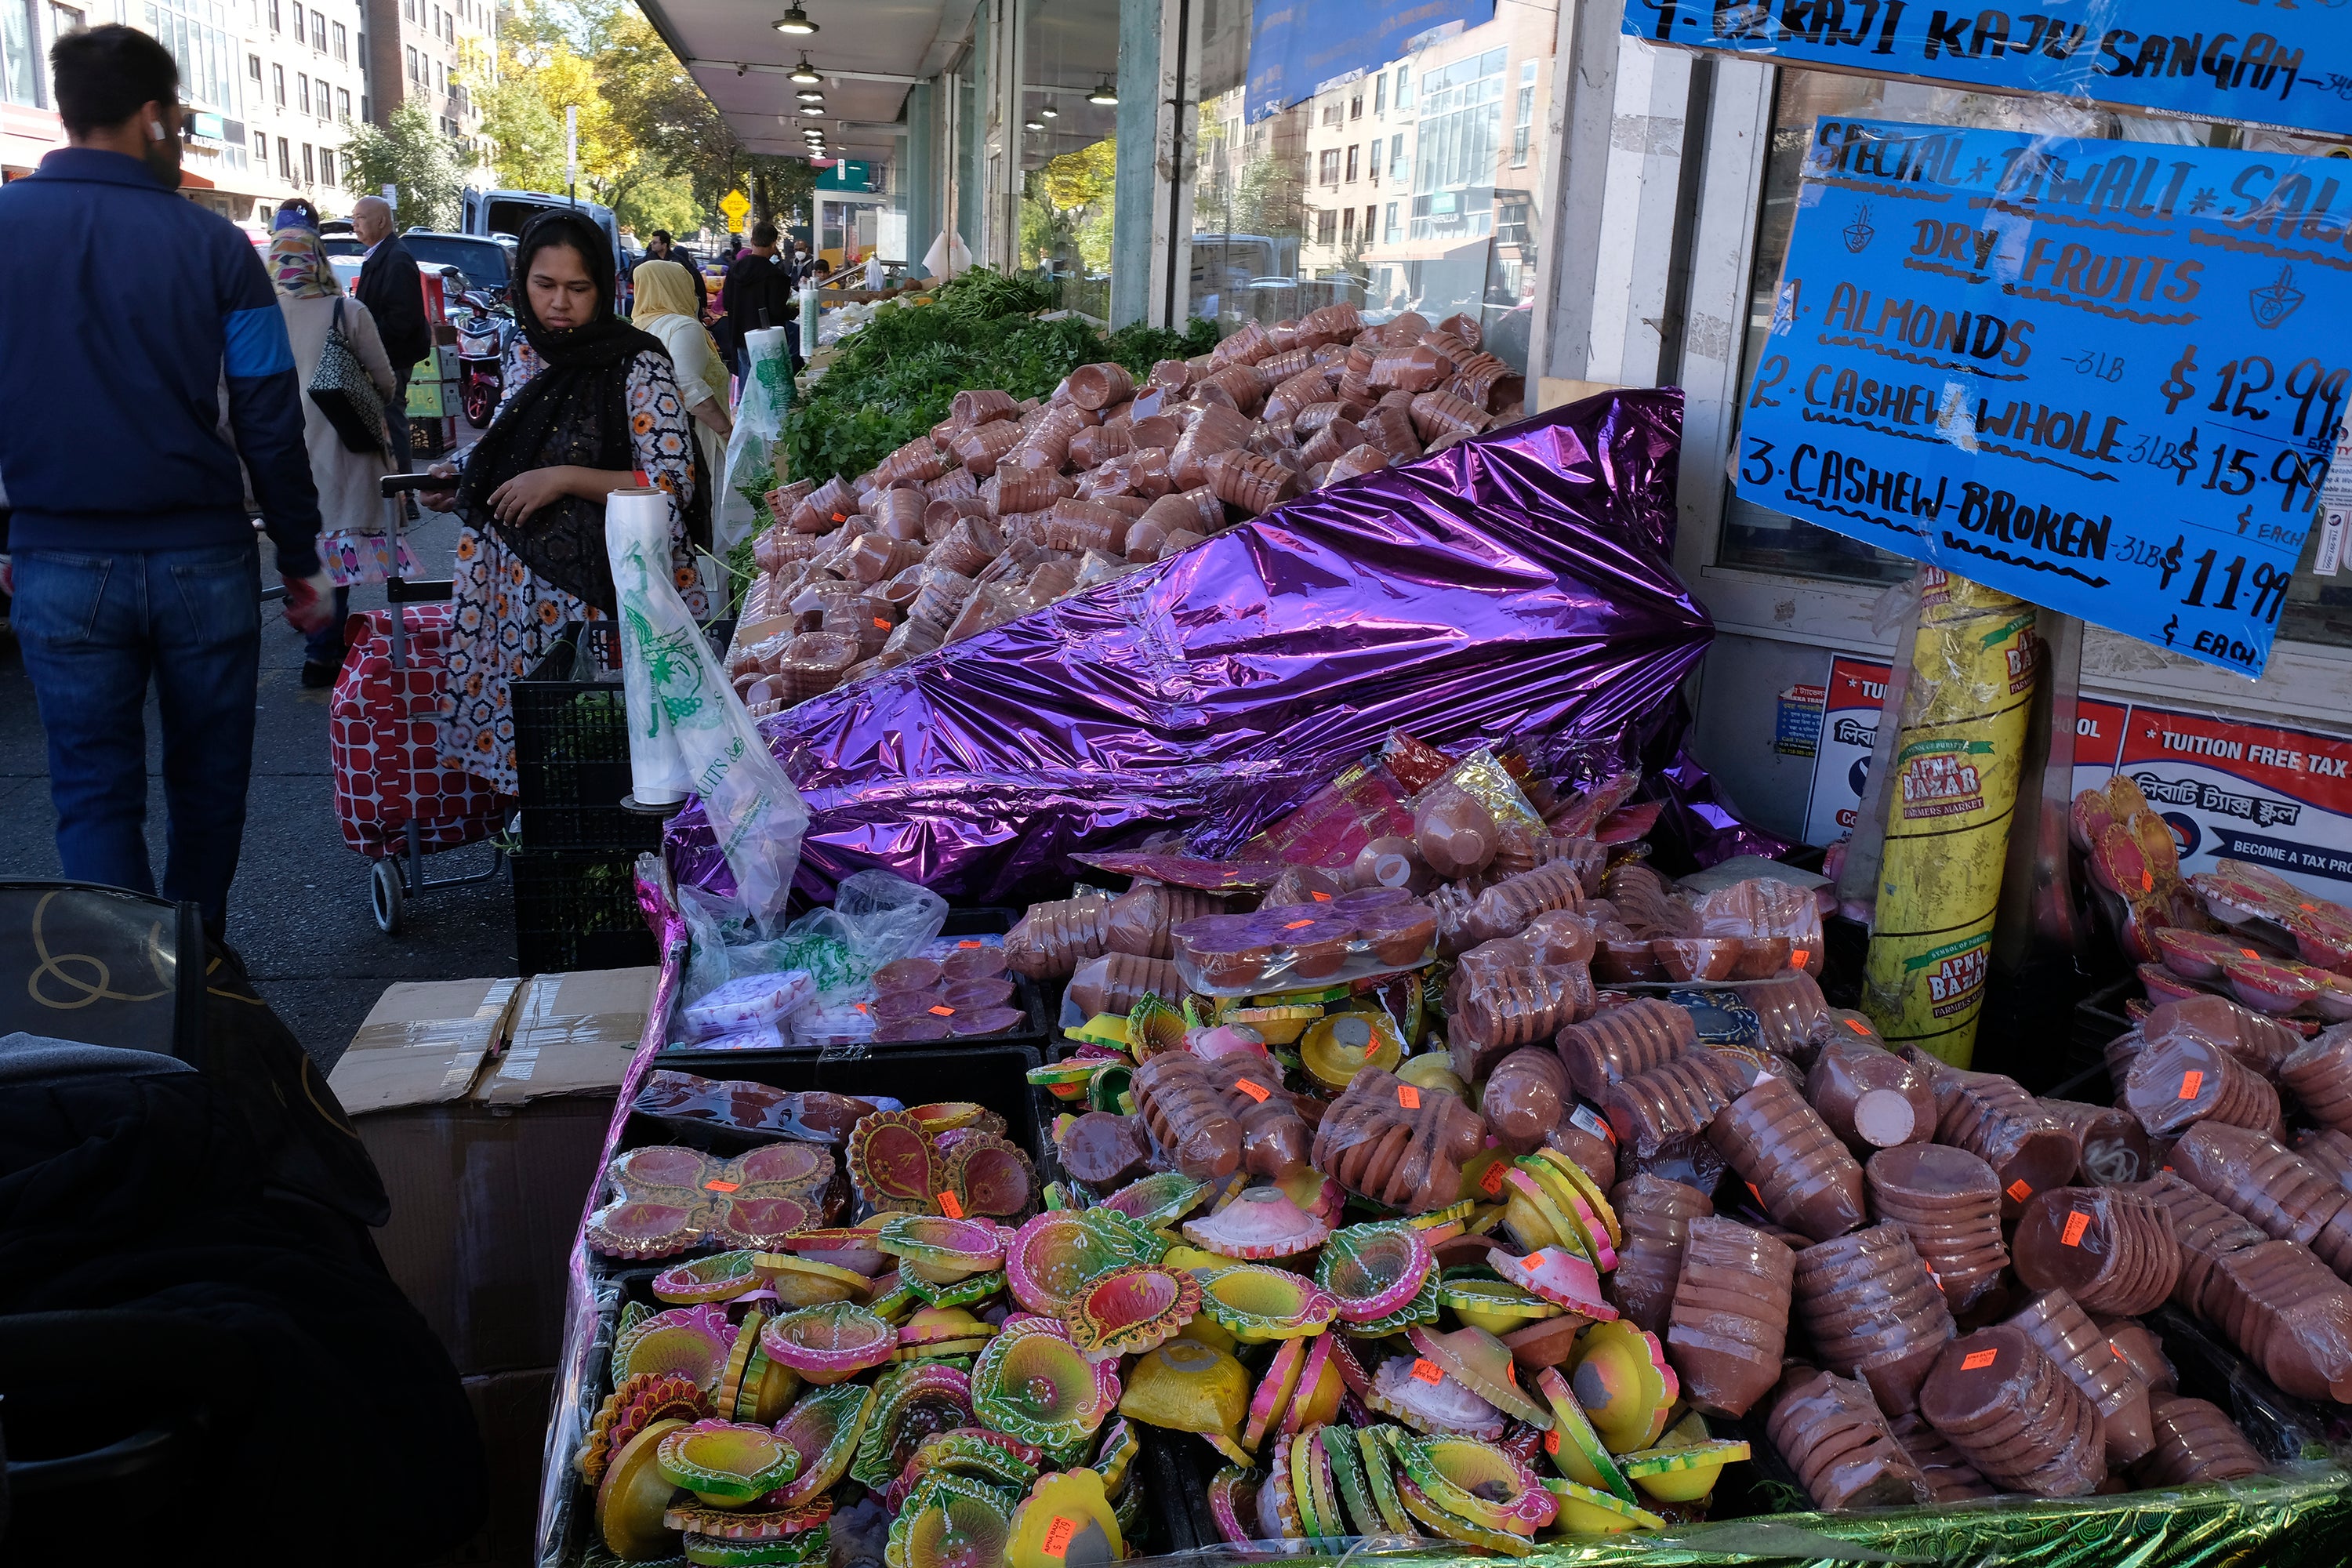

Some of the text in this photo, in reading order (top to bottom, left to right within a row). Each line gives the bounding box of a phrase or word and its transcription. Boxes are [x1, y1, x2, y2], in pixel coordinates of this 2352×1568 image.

[1924, 9, 2087, 60] KAJU
[2092, 30, 2305, 100] SANGAM
[1817, 122, 1964, 186] SPECIAL
[1994, 147, 2198, 220] DIWALI
[1824, 282, 2035, 367] ALMONDS
[1911, 757, 1958, 779] APNA
[2162, 731, 2349, 779] TUITION FREE TAX
[1904, 768, 1978, 800] BAZAR
[1904, 798, 1982, 818] FARMERS MARKET
[2234, 840, 2285, 861] BECOME
[2288, 851, 2297, 863] A
[2302, 853, 2326, 869] TAX
[1931, 946, 1958, 959] SYMBOL
[1942, 949, 1984, 979] APNA
[1934, 996, 1971, 1017] FARMERS
[1425, 1374, 1439, 1382] APNA
[1044, 1518, 1062, 1553] APNA BAZAR
[1055, 1521, 1071, 1539] 1.29
